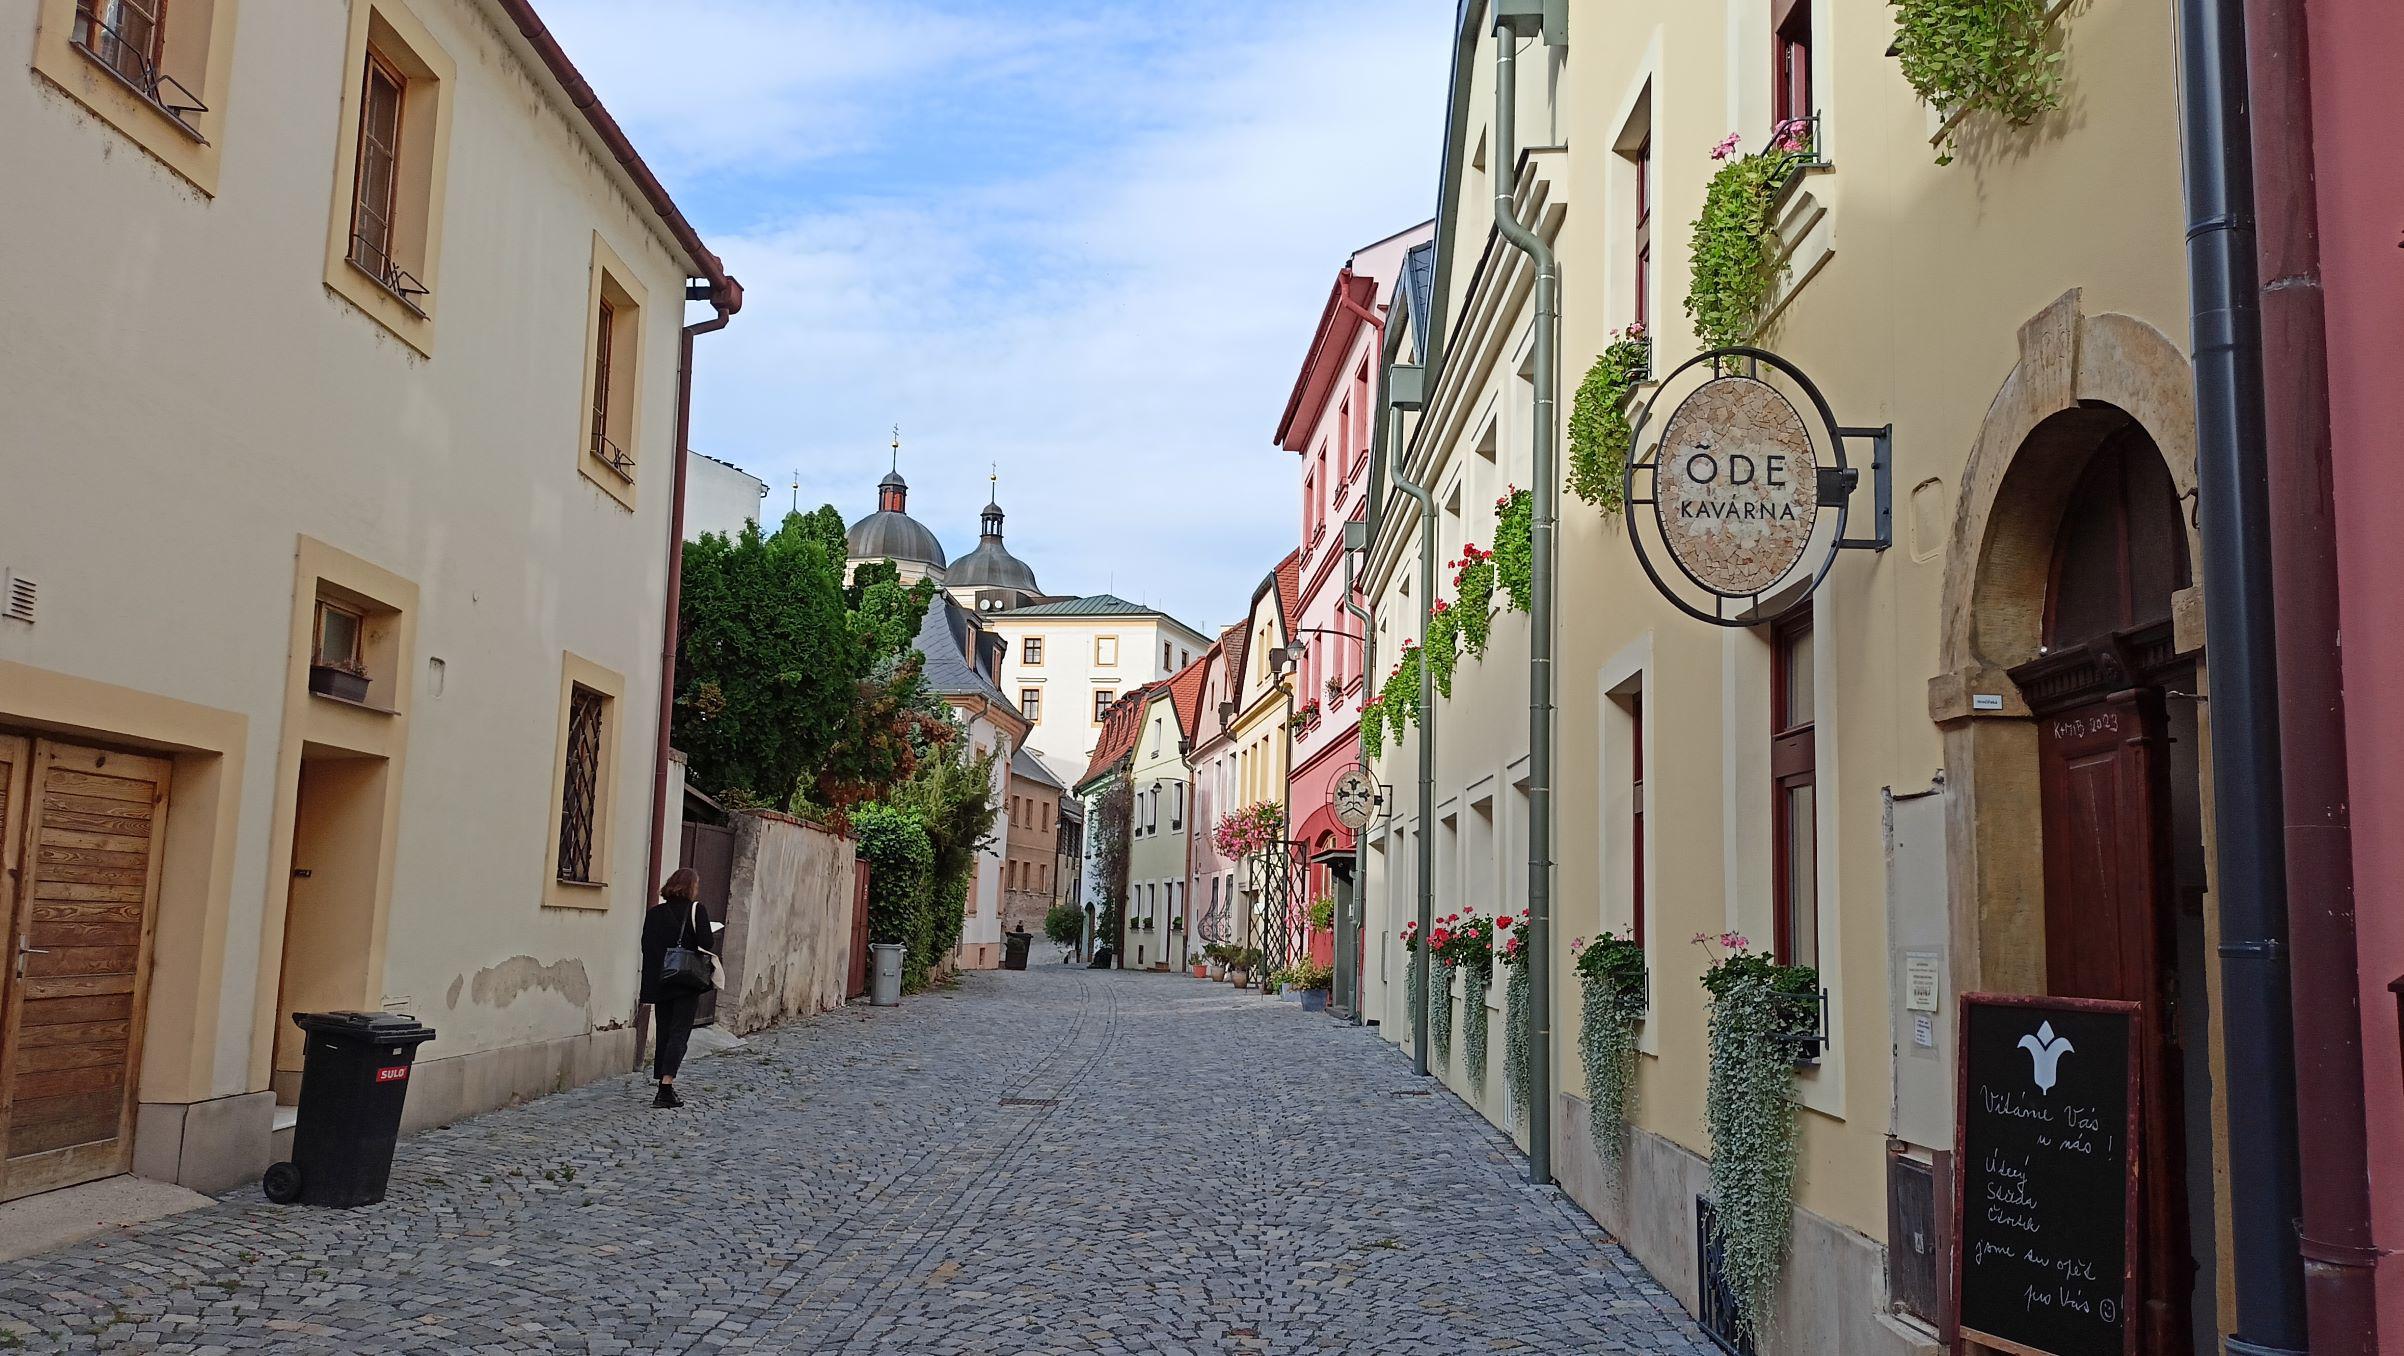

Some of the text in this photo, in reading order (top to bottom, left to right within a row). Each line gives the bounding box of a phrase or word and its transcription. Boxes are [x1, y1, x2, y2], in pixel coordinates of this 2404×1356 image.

[1681, 494, 1796, 521] KAVÁRNA
[2089, 713, 2119, 732] 2023
[380, 1068, 405, 1080] SULO
[1980, 1085, 2099, 1131] Vítáme Vás
[2037, 1135, 2051, 1146] u
[2060, 1132, 2092, 1154] nás
[1975, 1240, 2015, 1265] jsme
[2056, 1258, 2096, 1281] opět
[2024, 1284, 2051, 1312] pro
[2060, 1286, 2090, 1314] Vás
